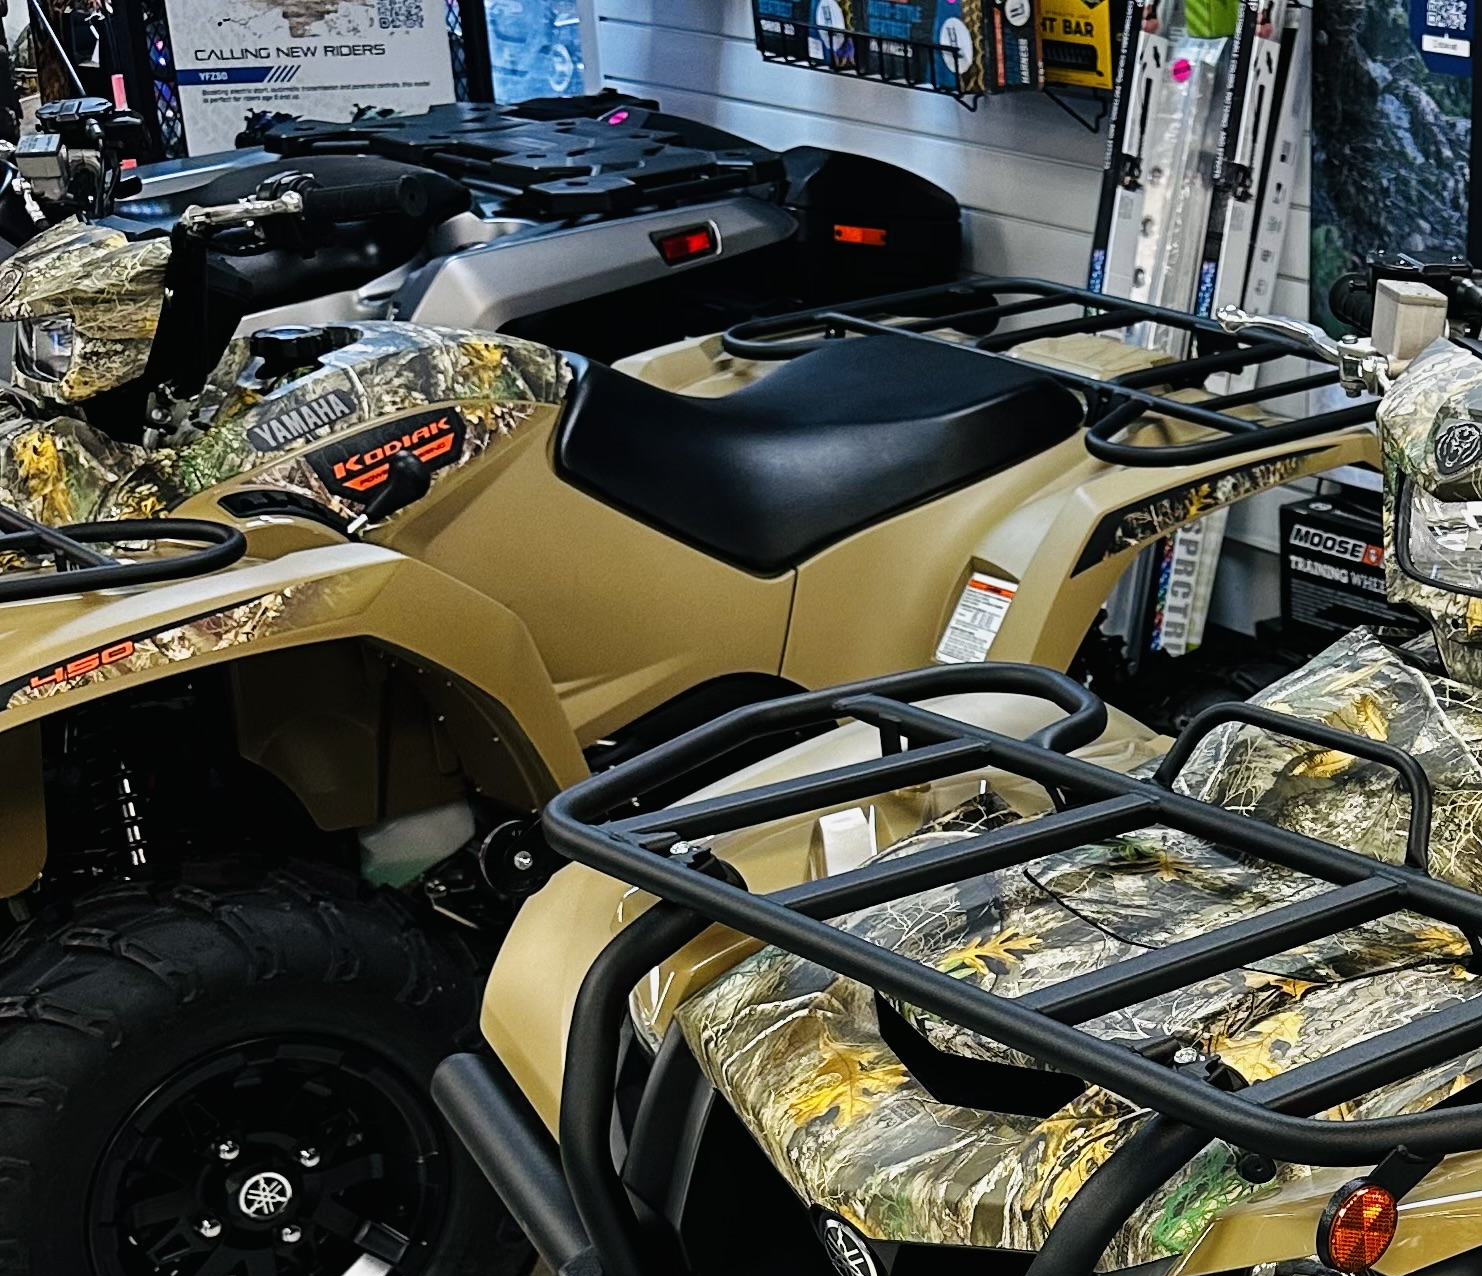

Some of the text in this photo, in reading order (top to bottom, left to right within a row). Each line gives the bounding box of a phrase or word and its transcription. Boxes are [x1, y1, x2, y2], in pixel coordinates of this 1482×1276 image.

[1062, 18, 1094, 39] BAR
[194, 43, 386, 62] CALLING NEW RIDERS
[253, 393, 350, 447] YAMAHA
[332, 416, 451, 480] KODIAK
[1291, 525, 1365, 561] MOOSE
[1289, 554, 1350, 584] TRAINING
[29, 640, 136, 689] 450
